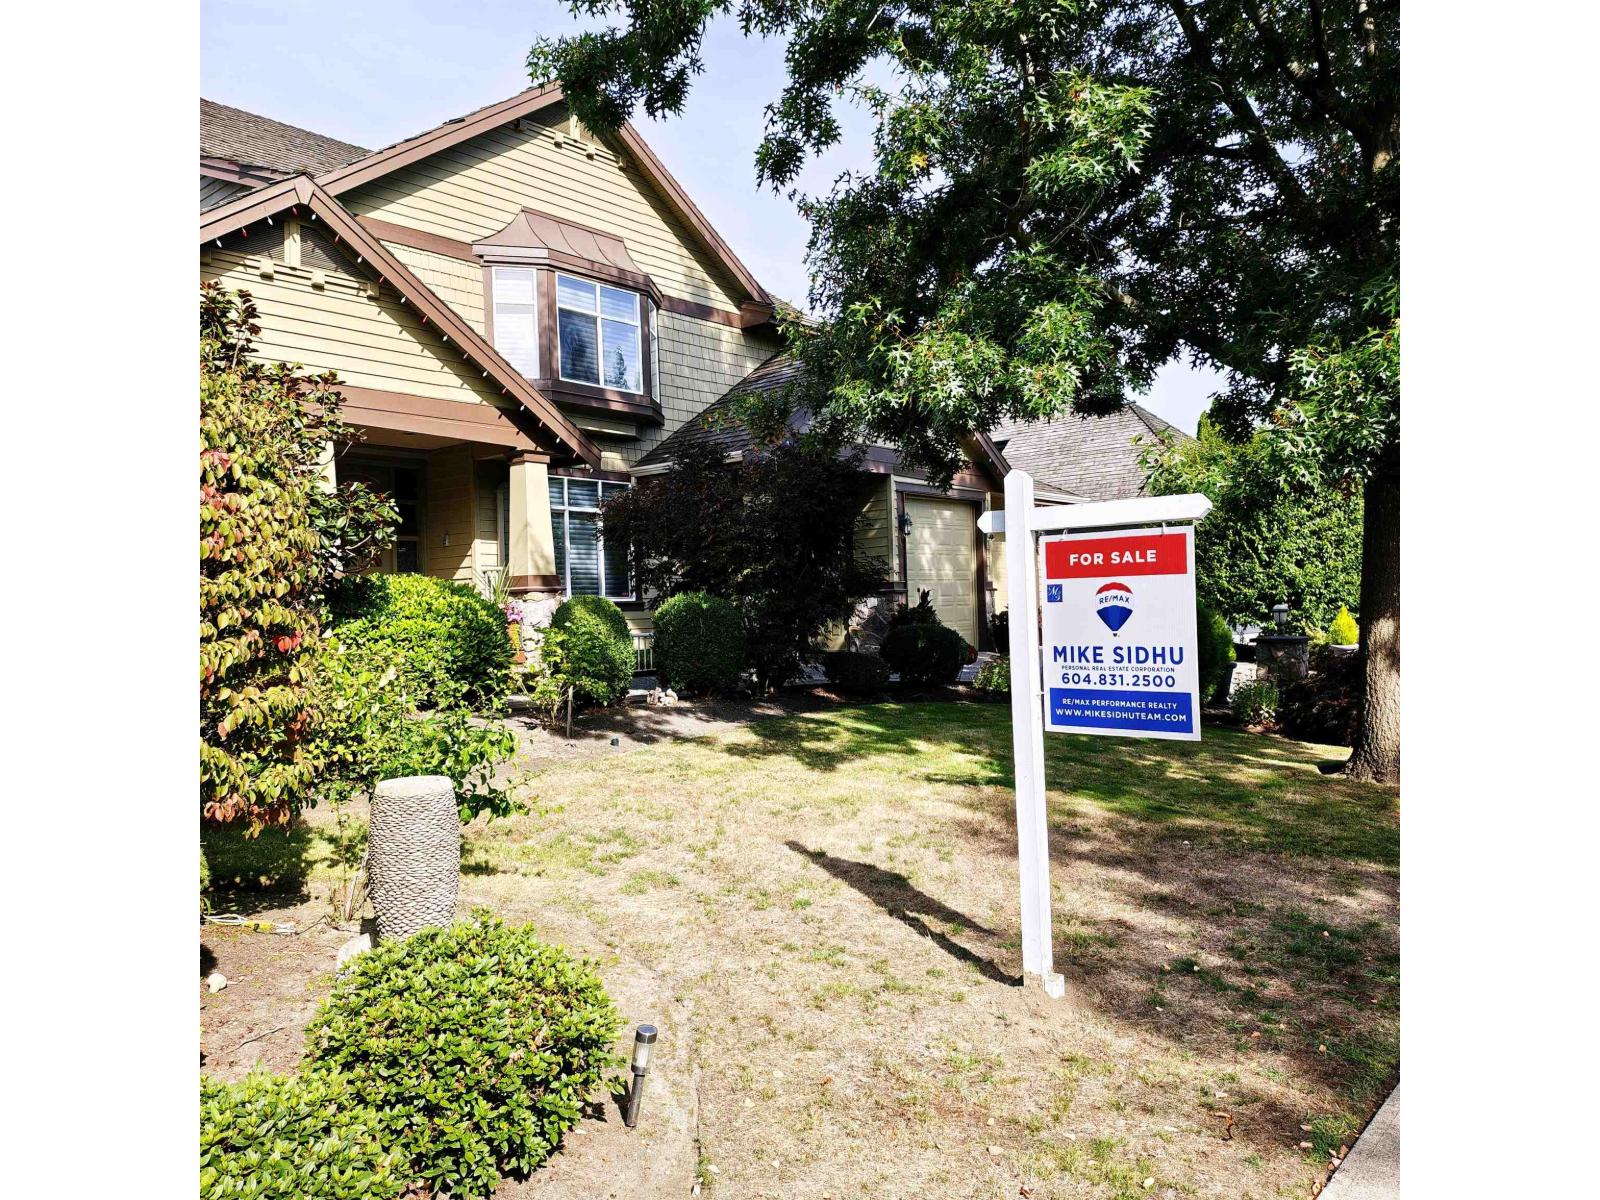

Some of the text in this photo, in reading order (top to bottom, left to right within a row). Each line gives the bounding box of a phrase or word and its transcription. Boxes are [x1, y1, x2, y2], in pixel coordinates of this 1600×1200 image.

[1069, 550, 1157, 566] FOR SALE
[1099, 595, 1130, 604] RE/MAX
[1053, 646, 1184, 665] MIKE SIDHU
[1062, 673, 1176, 687] 604.831.2500
[1092, 700, 1146, 708] PERFORMANCE
[1056, 709, 1187, 721] WWW.MIKESIDHUTEAM.COM
